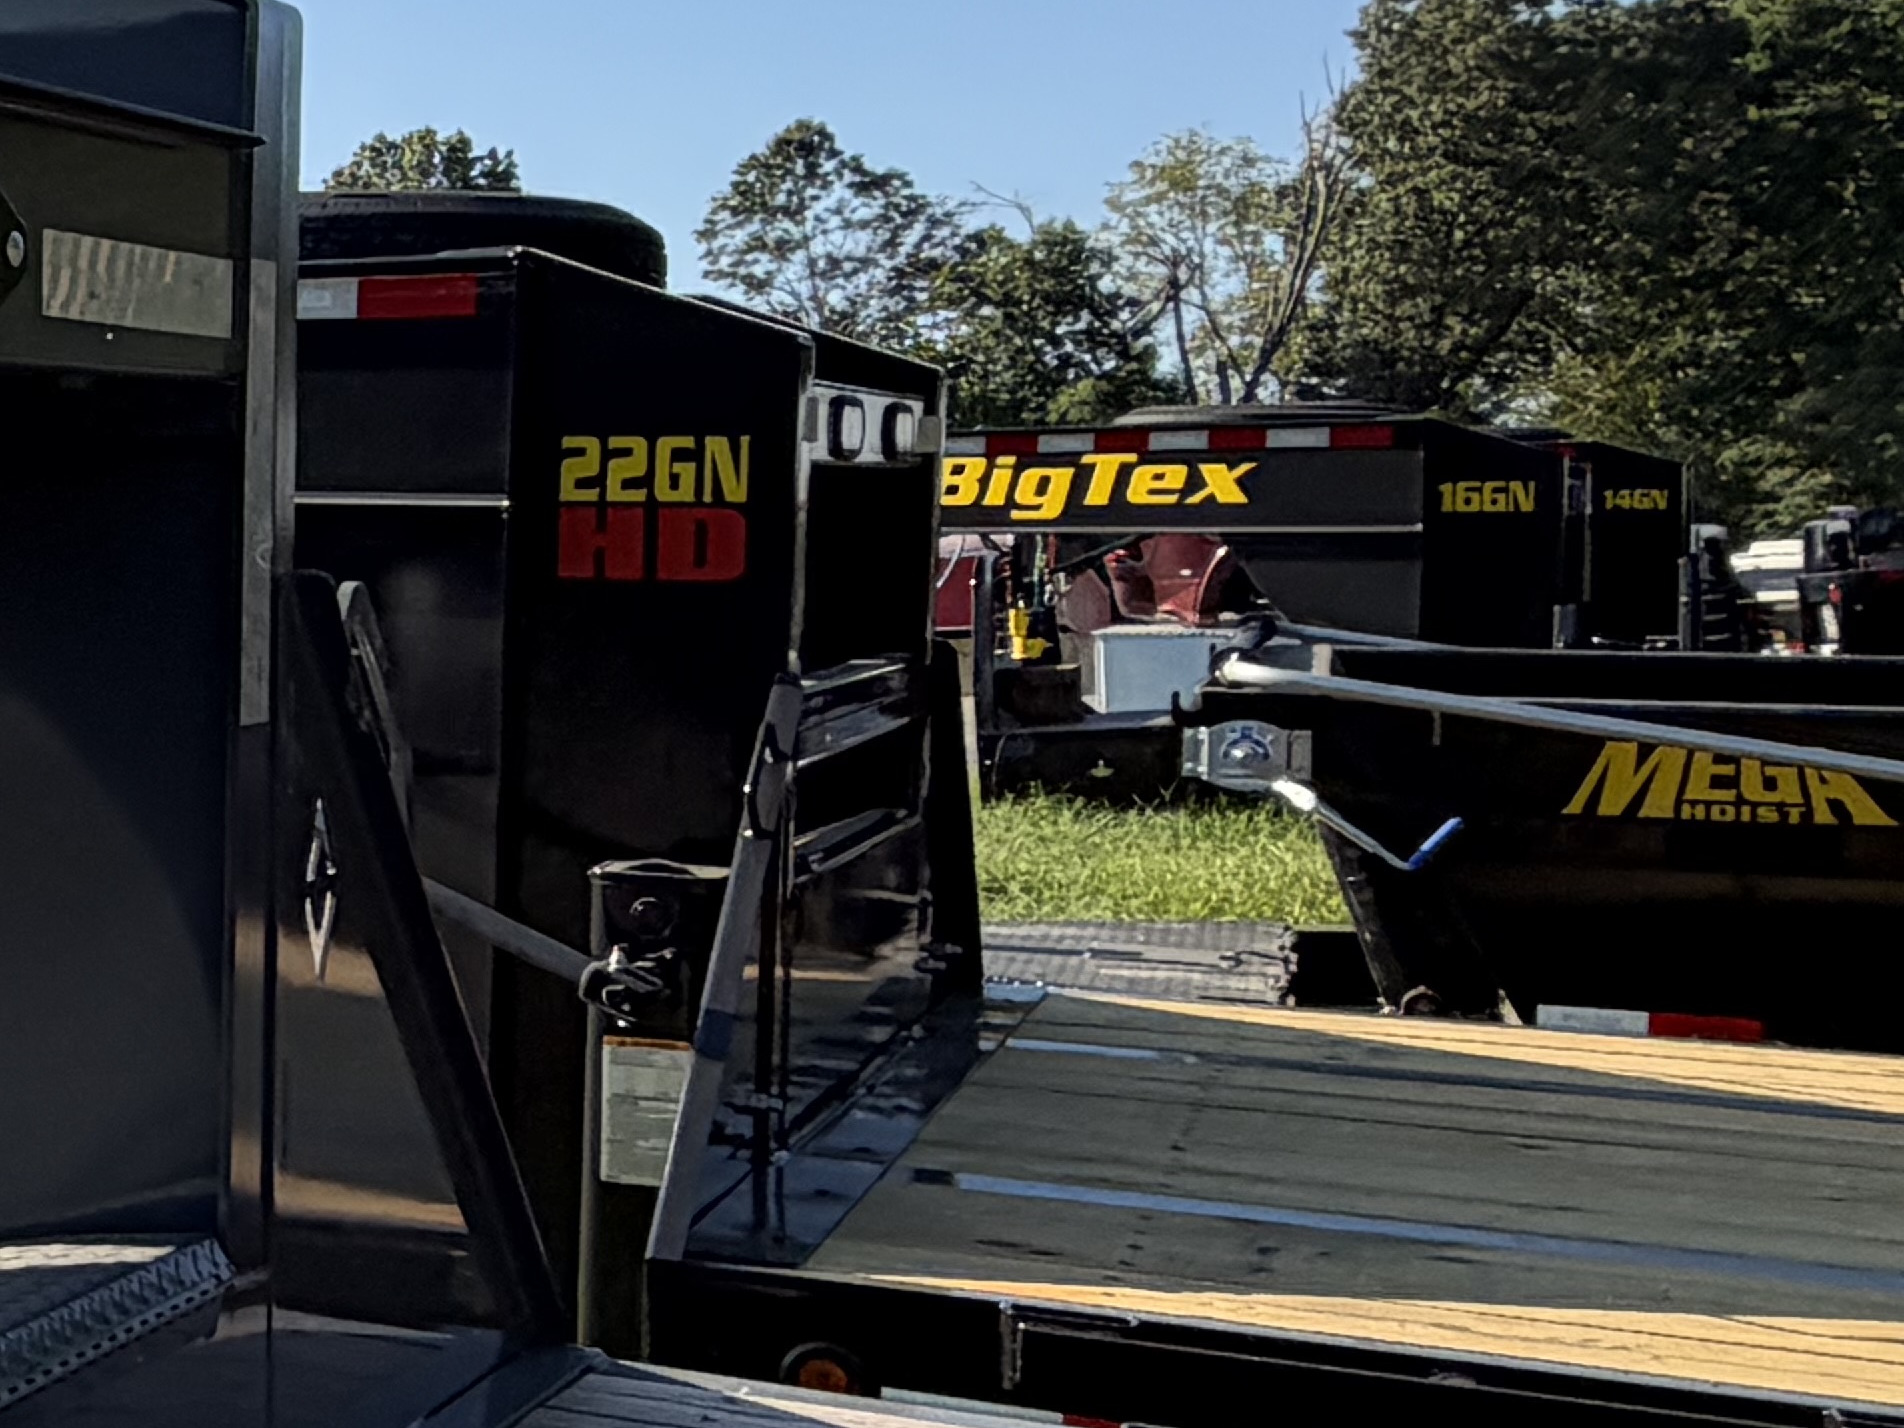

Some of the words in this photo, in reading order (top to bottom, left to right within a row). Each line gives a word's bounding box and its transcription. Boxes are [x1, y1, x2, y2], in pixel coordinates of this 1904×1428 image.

[559, 435, 751, 503] 22GN
[940, 452, 1259, 521] BigTex
[1438, 480, 1536, 513] 16GN
[1602, 488, 1669, 510] 14GN
[558, 506, 746, 580] HD
[1560, 740, 1900, 826] MEGA
[1680, 802, 1807, 824] HOIST
